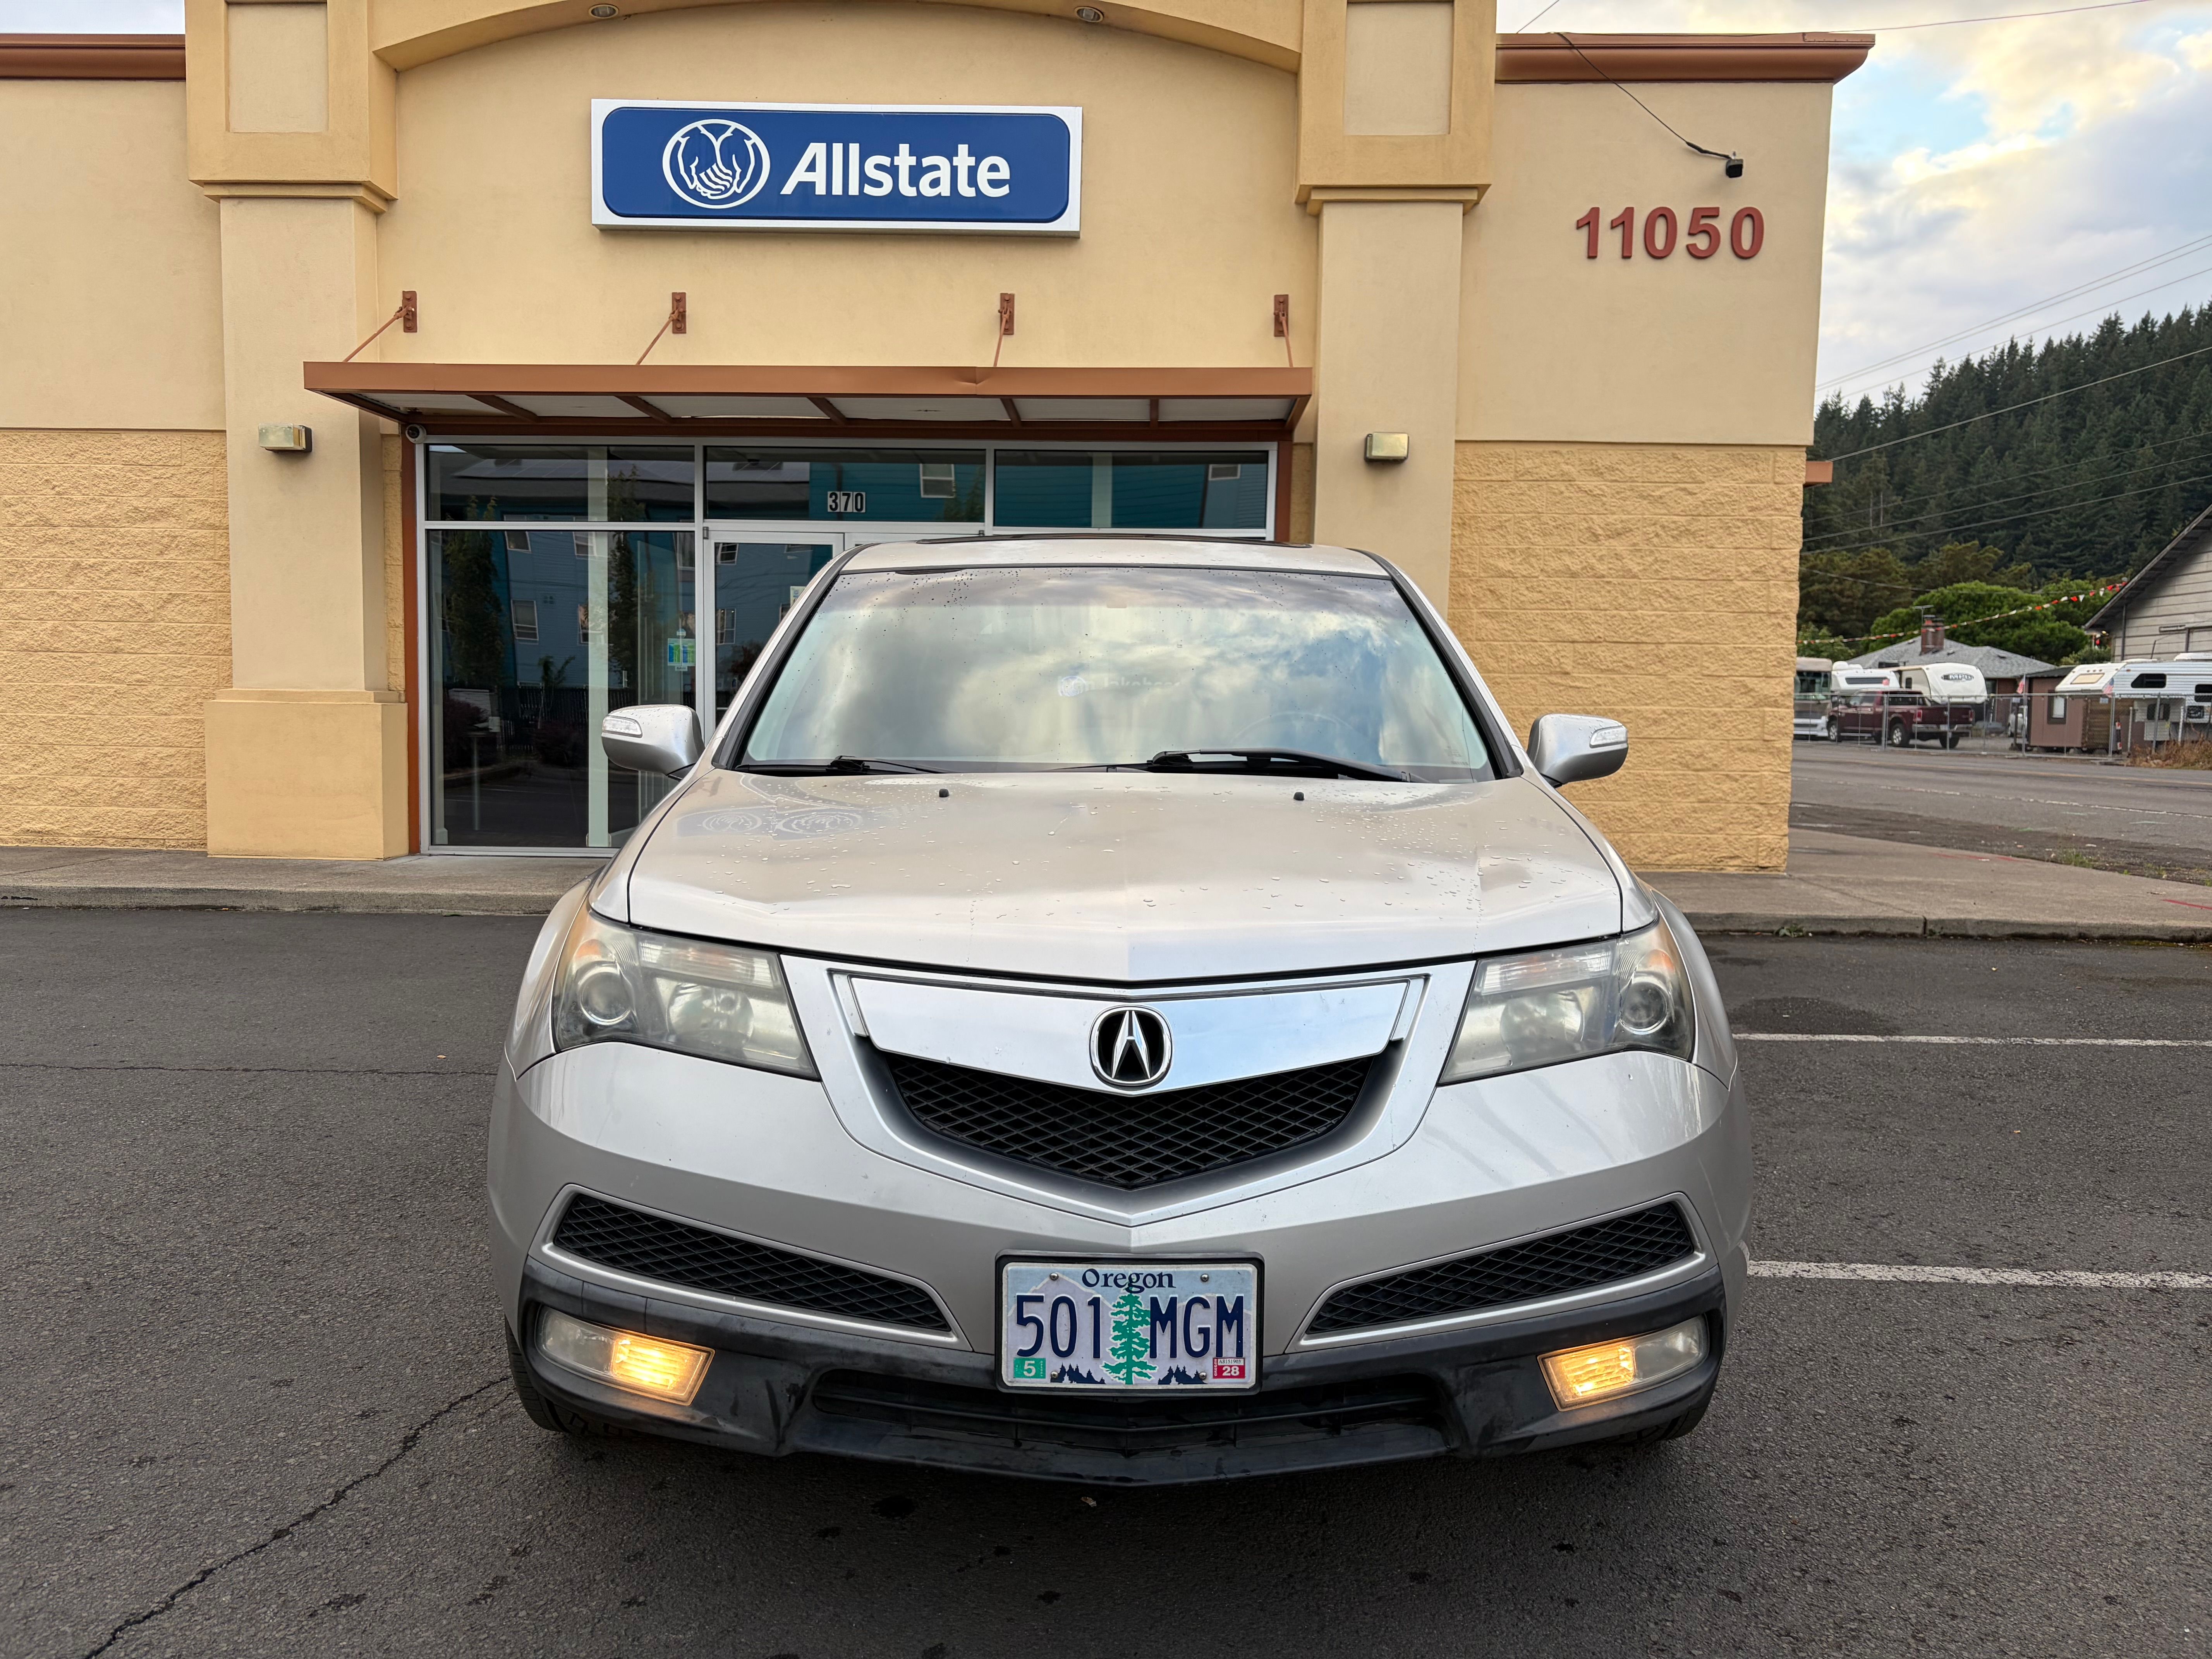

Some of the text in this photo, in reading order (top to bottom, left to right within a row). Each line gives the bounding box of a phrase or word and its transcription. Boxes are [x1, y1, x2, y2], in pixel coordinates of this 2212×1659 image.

[780, 142, 1010, 198] Allstate
[1576, 206, 1764, 259] 11050
[829, 492, 864, 512] 370
[1082, 1268, 1176, 1294] Oregon
[1017, 1295, 1244, 1358] 501 MGM
[1023, 1360, 1036, 1377] 5
[1222, 1366, 1240, 1376] 28
